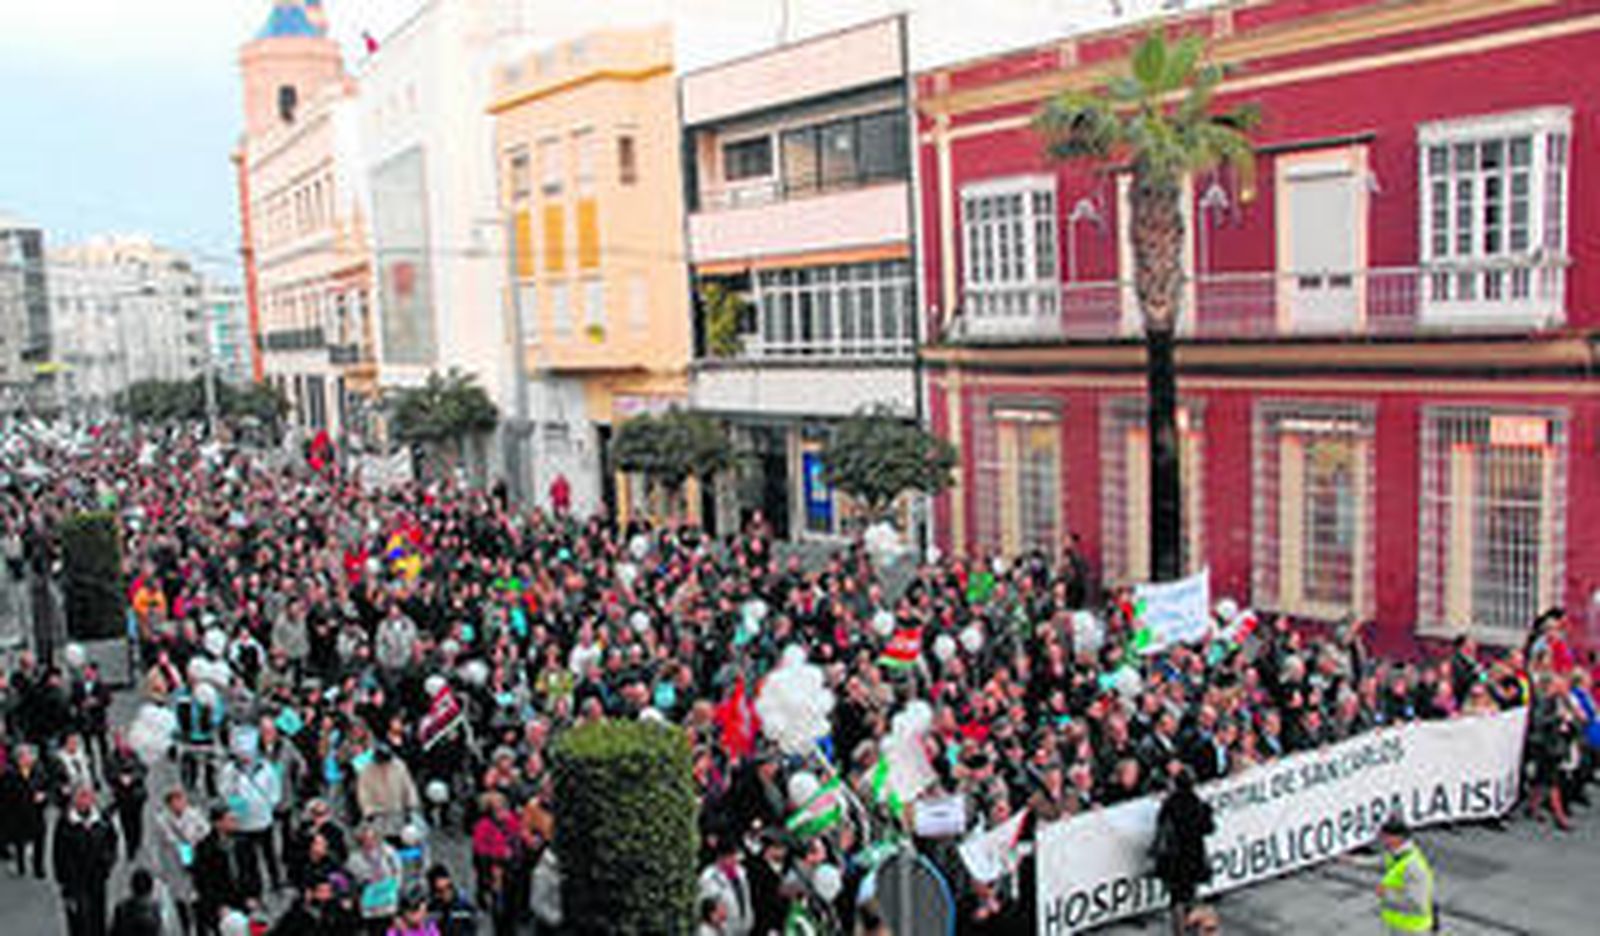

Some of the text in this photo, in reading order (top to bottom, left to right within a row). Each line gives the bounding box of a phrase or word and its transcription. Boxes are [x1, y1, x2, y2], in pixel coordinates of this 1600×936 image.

[1271, 767, 1297, 799] DE
[1300, 755, 1341, 788] SAN
[1046, 876, 1171, 935] HOSPIT
[1209, 819, 1335, 880] PÚBLICO
[1411, 783, 1450, 821] LA
